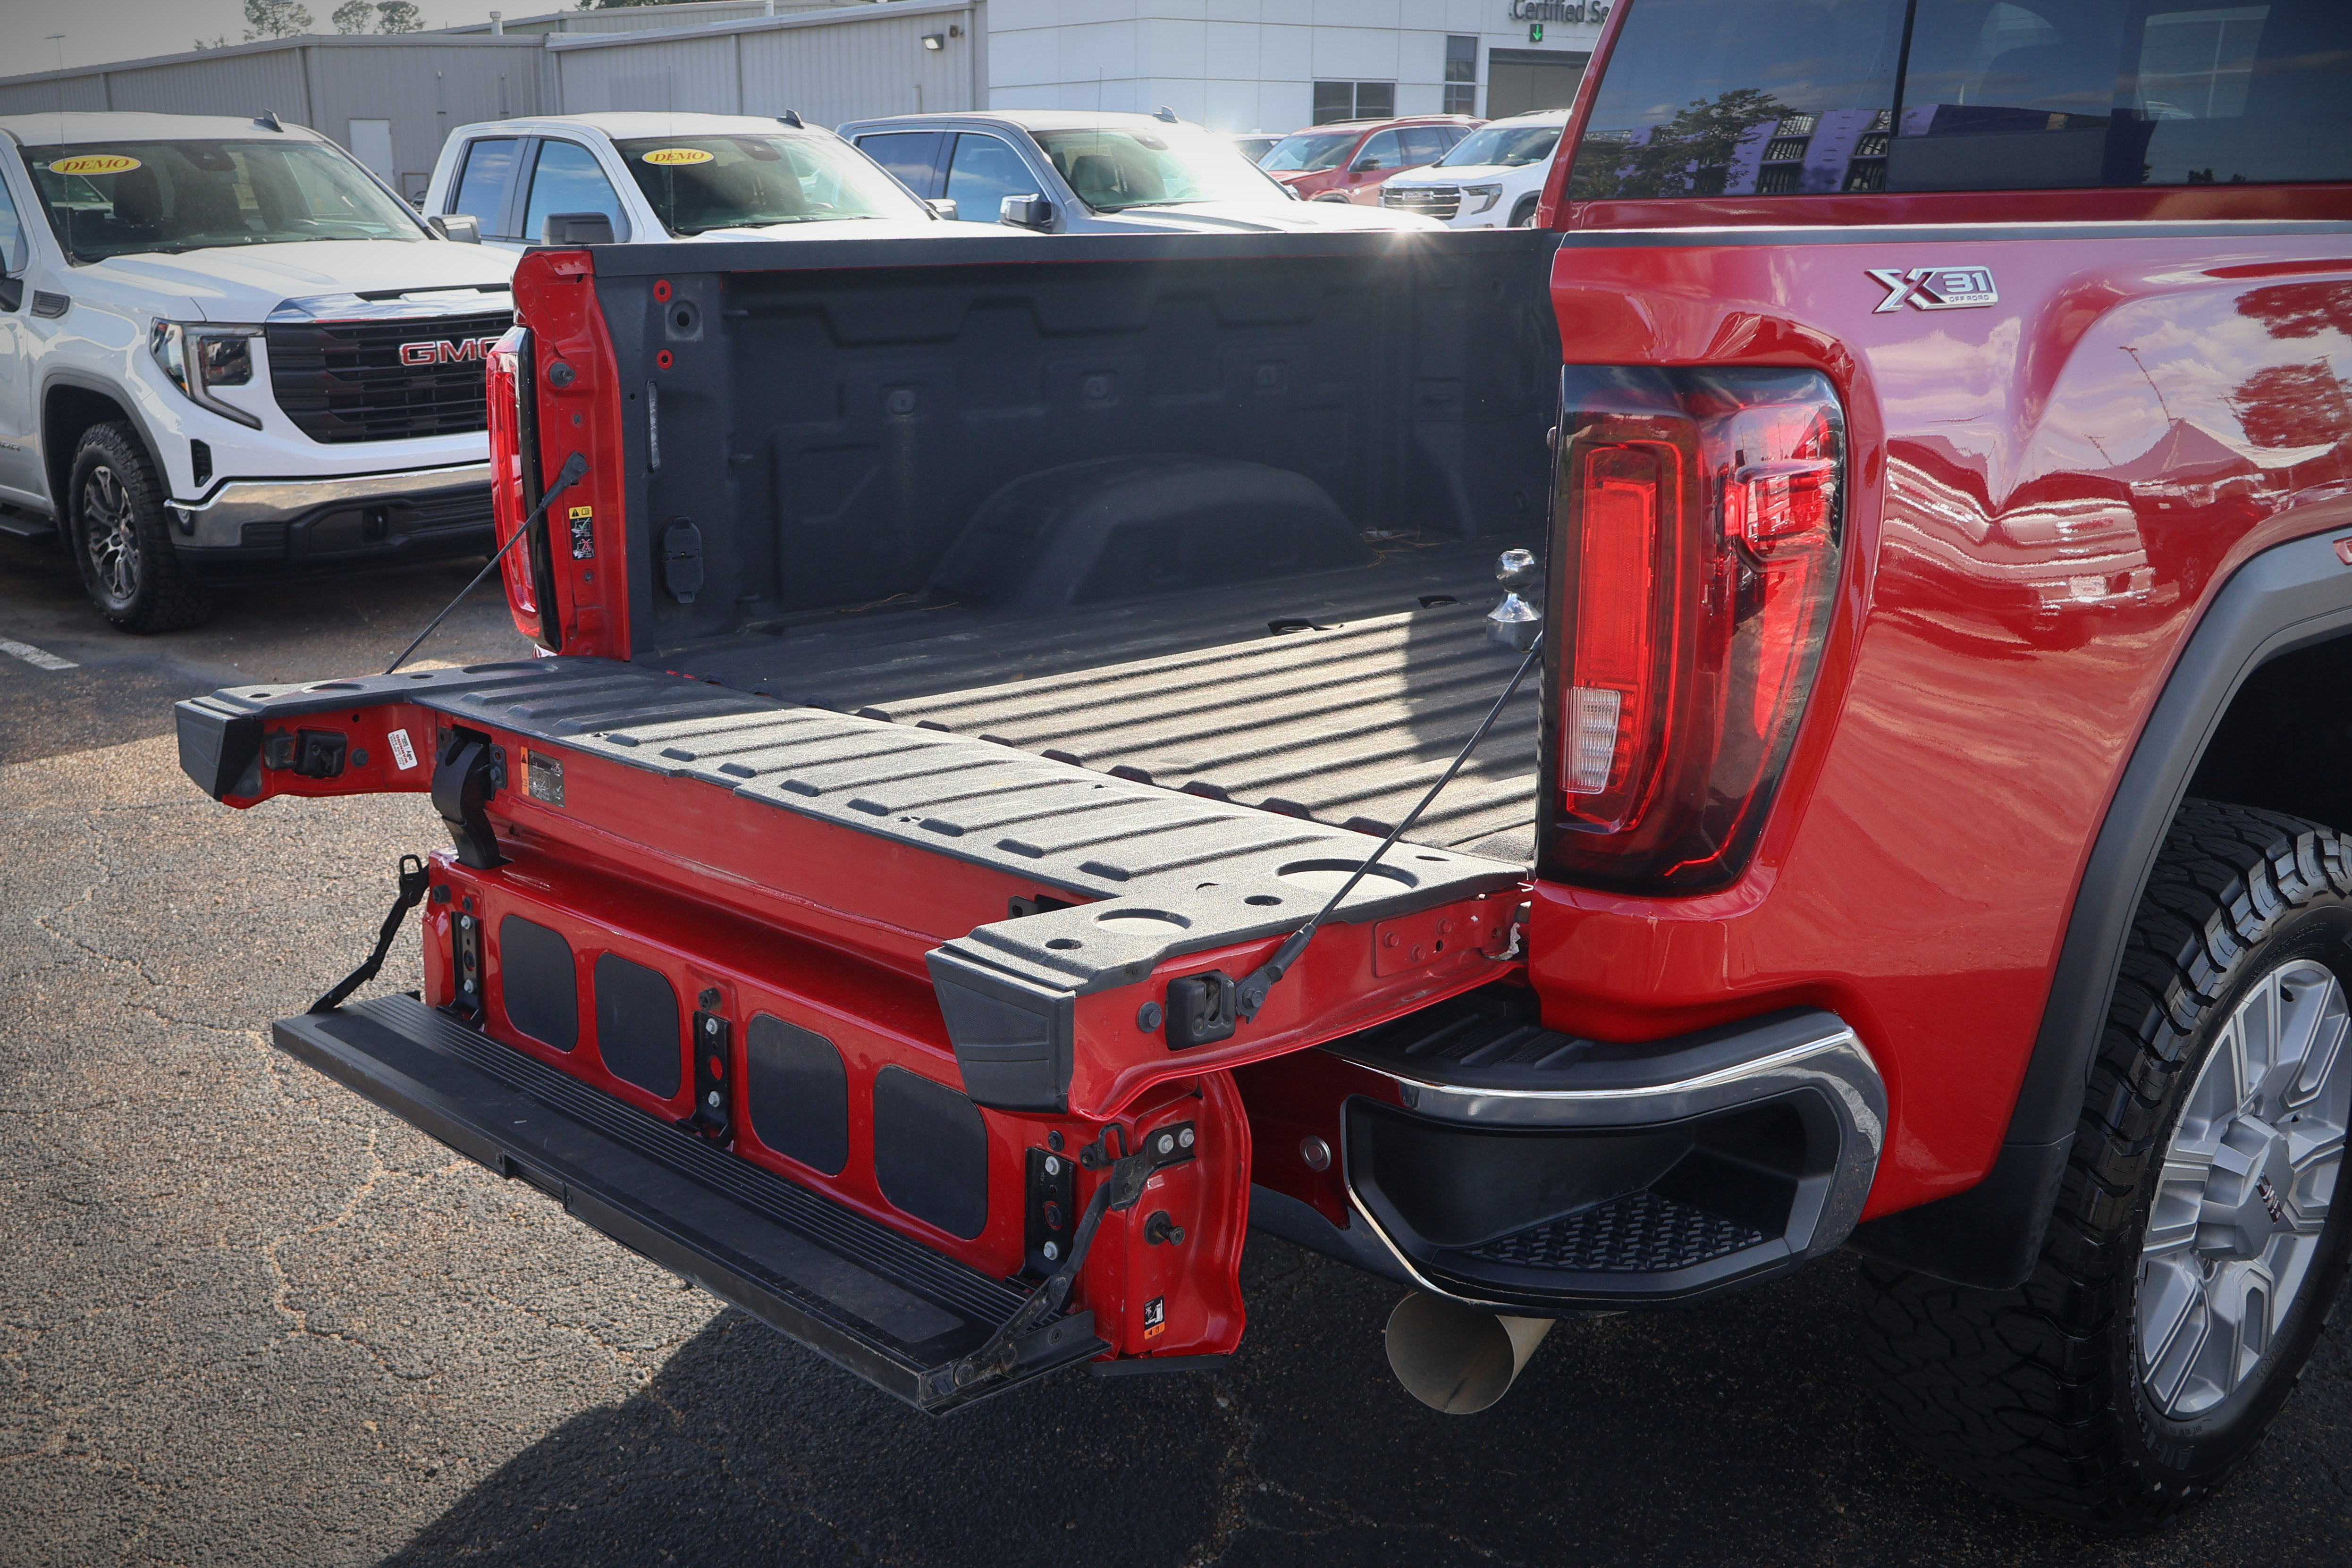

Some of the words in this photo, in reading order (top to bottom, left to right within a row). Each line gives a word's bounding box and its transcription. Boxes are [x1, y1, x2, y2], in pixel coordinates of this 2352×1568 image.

[1512, 0, 1585, 23] Certified
[61, 159, 130, 172] DEMO
[653, 152, 705, 162] DEMO
[395, 733, 409, 764] WARNING
